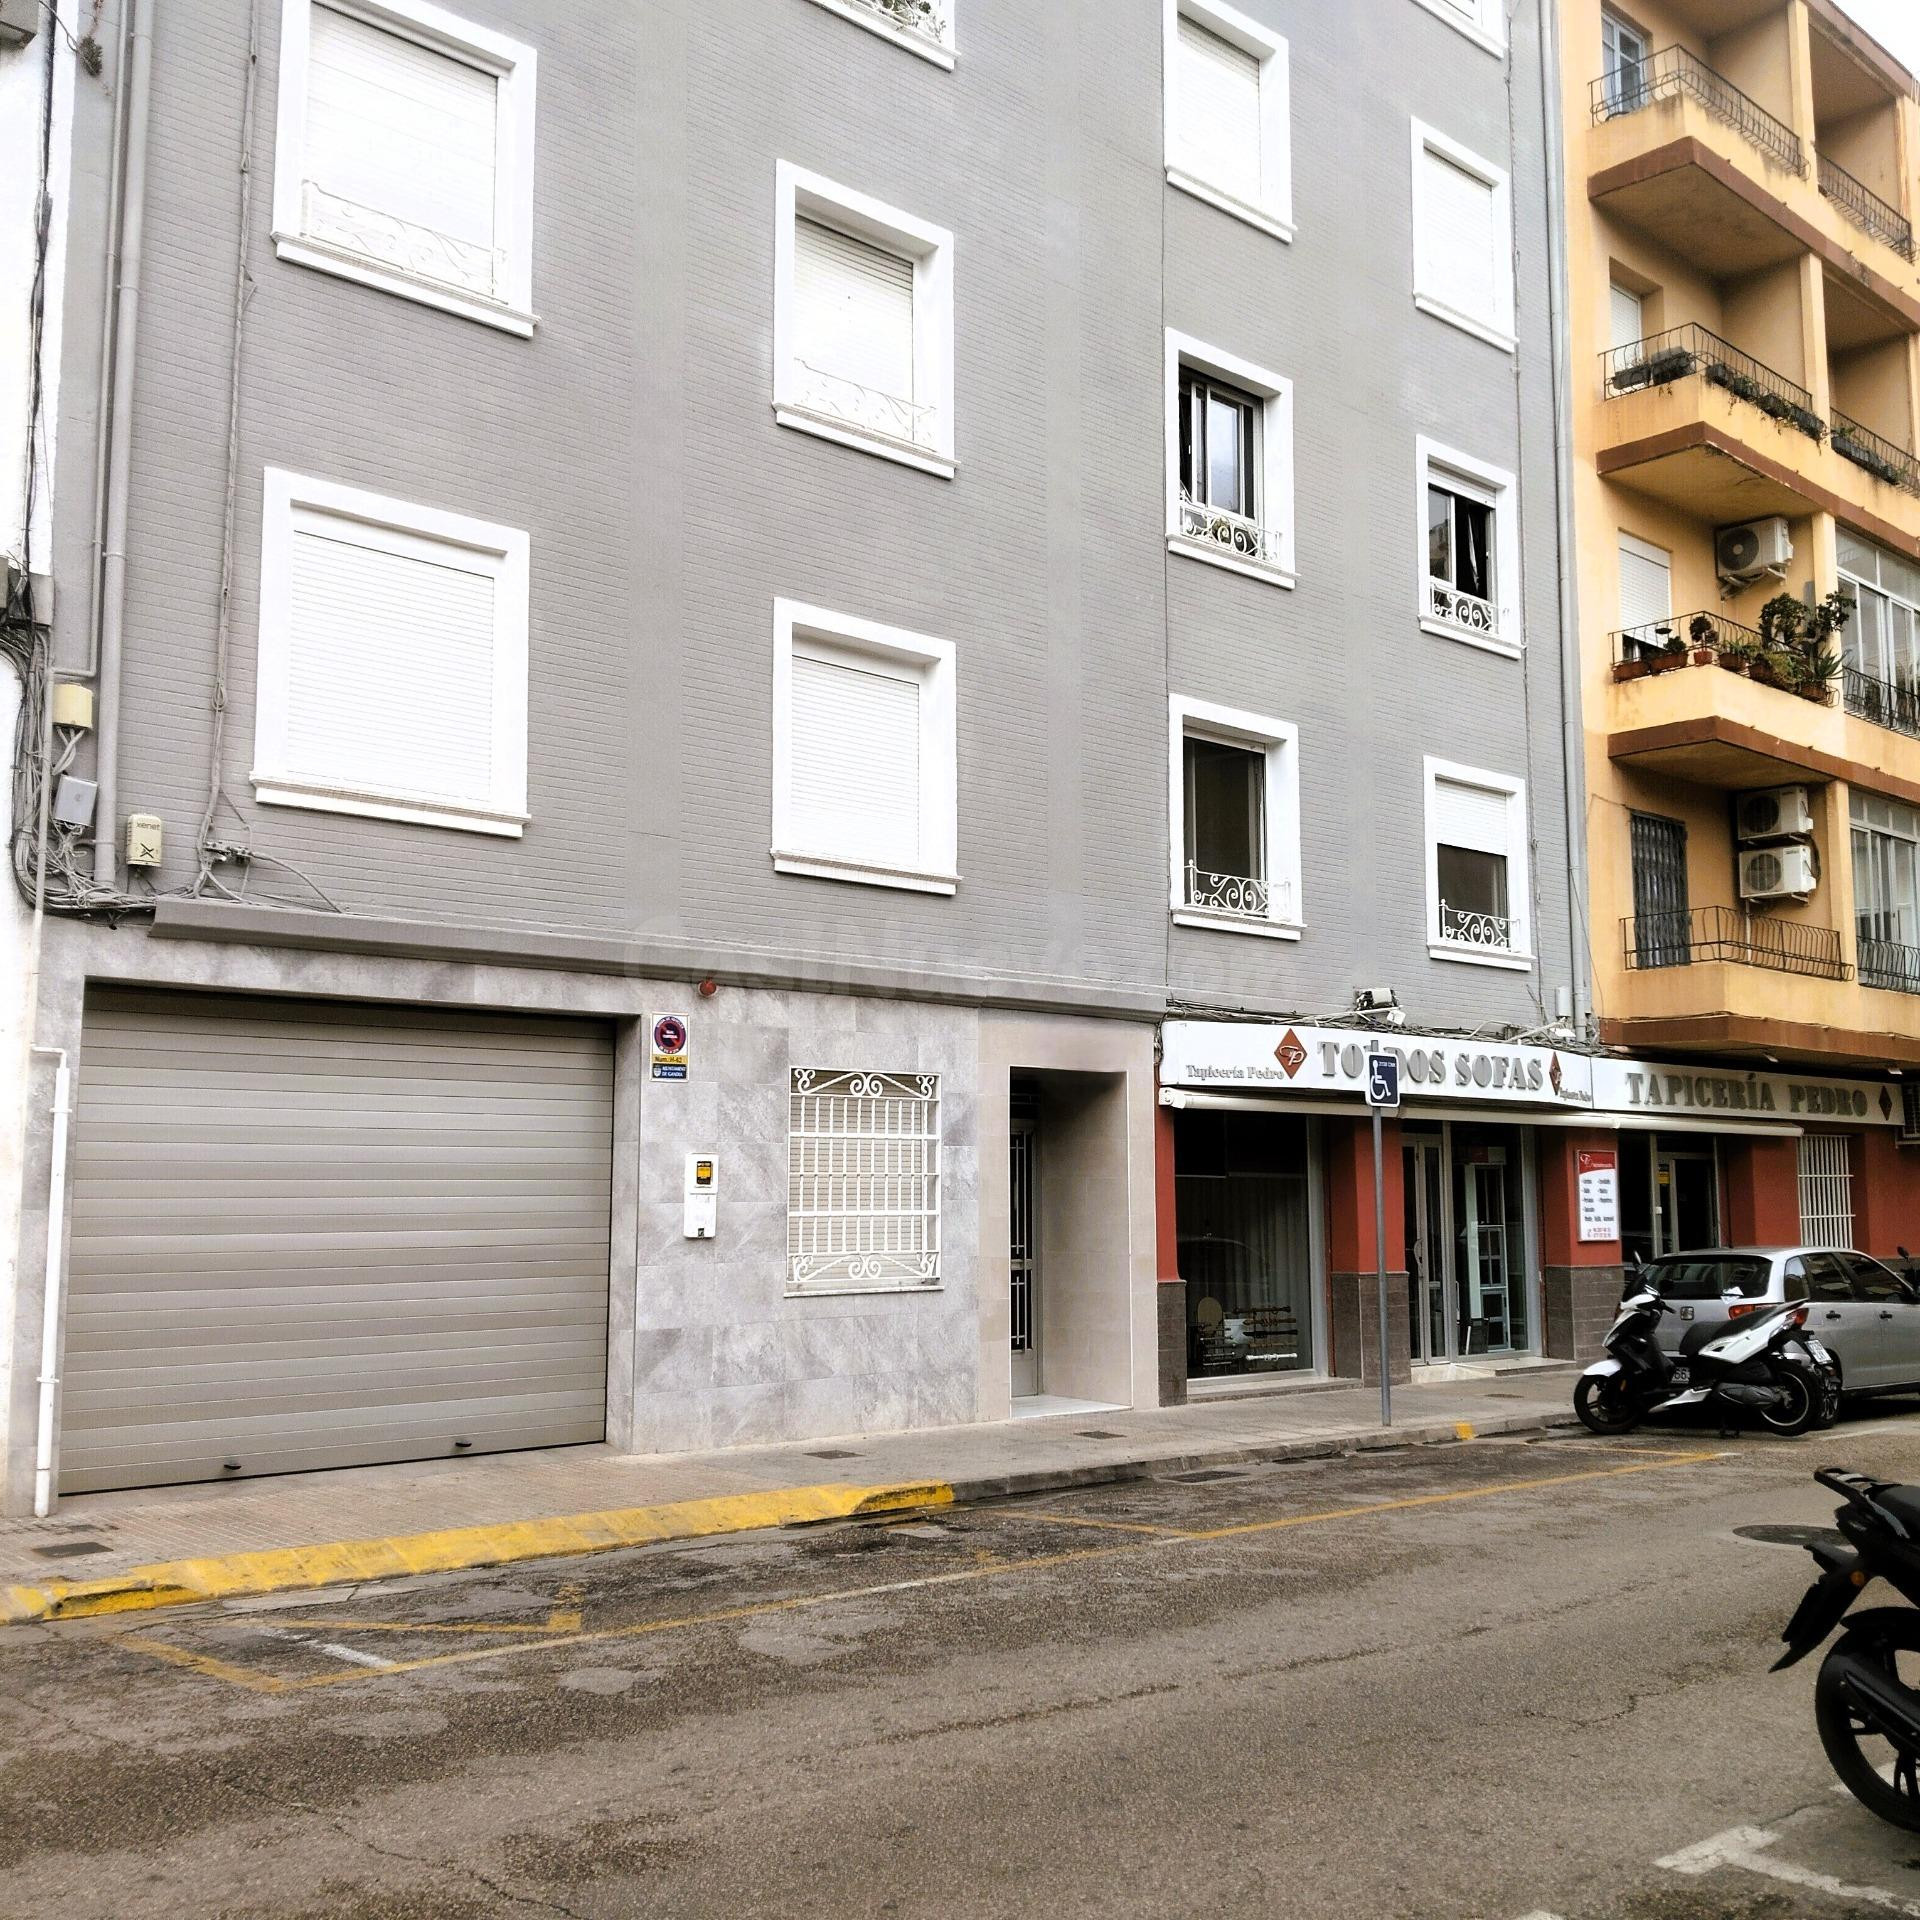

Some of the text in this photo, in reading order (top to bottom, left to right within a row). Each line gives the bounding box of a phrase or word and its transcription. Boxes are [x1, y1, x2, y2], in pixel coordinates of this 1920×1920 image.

[1246, 1066, 1285, 1080] Pedro
[1316, 1041, 1544, 1091] TOOS SOFAS
[1625, 1071, 1869, 1118] TAPICERÍA PEDRO
